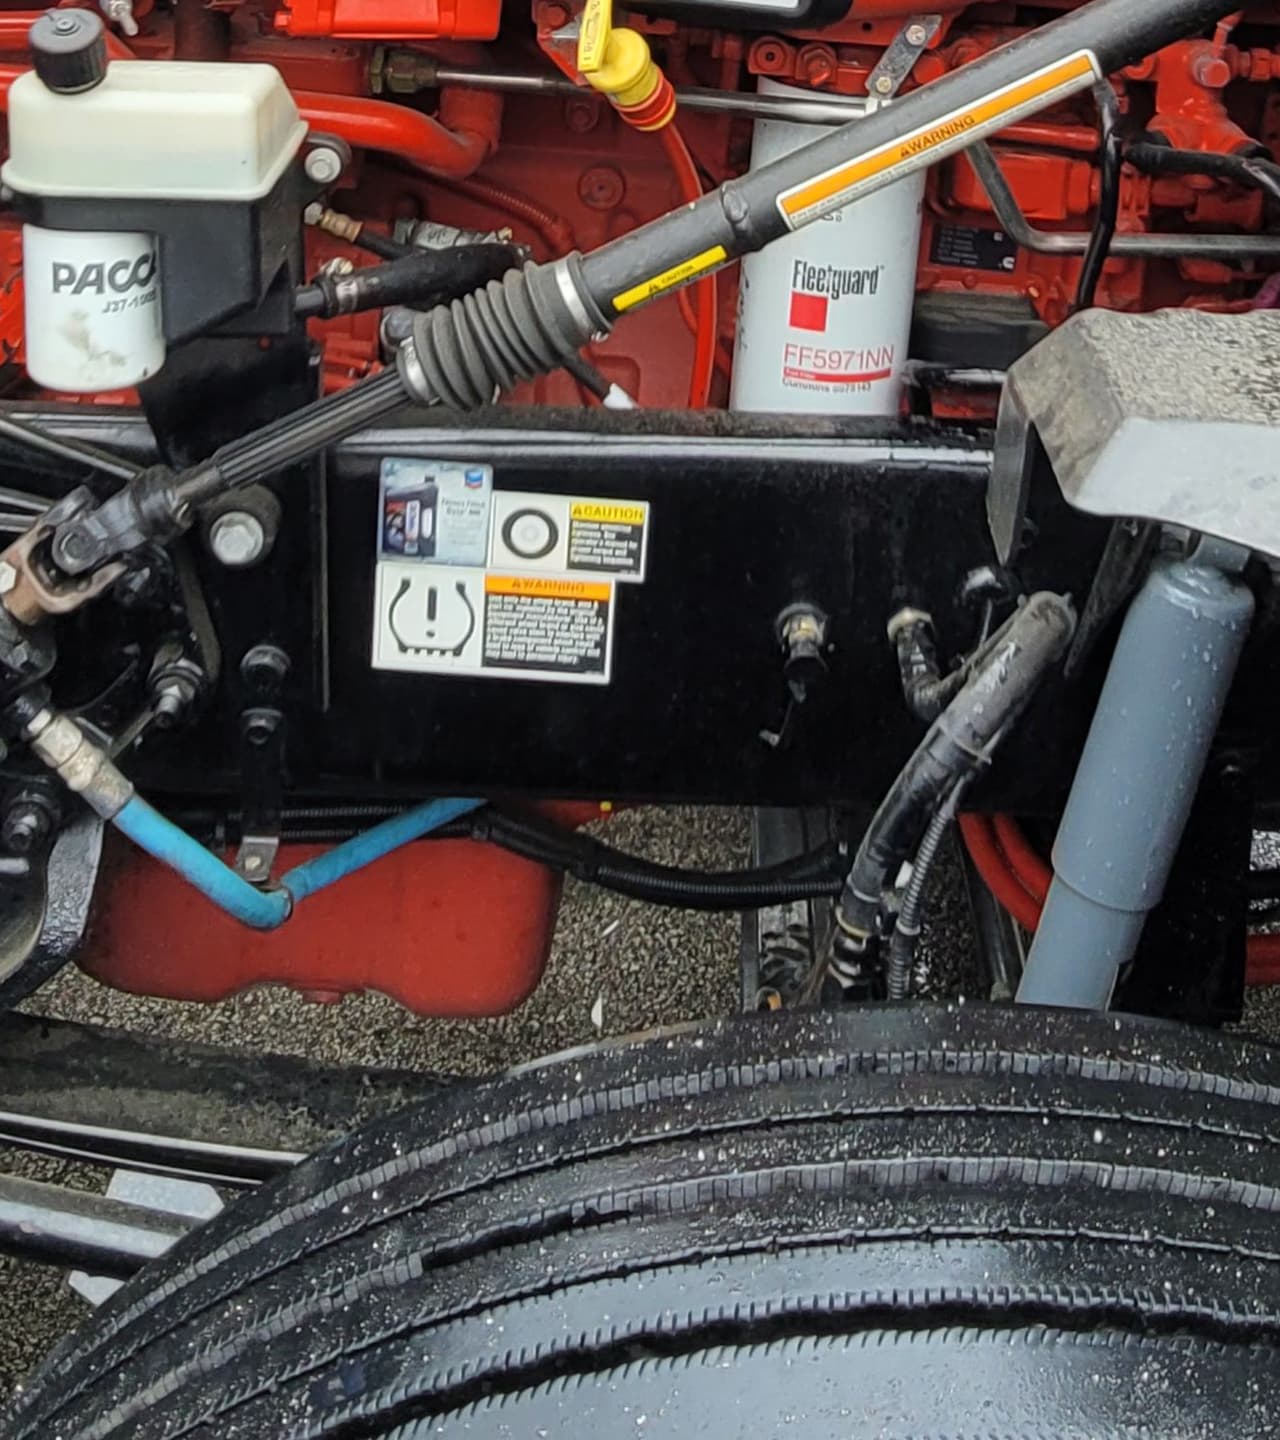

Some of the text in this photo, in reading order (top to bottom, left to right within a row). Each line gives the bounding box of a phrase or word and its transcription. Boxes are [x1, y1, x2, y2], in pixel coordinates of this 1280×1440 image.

[907, 115, 976, 154] WARNING
[792, 259, 880, 300] Fleetguard
[783, 342, 894, 371] FF5971NN
[584, 505, 643, 520] CAUTION
[523, 578, 585, 593] WARNING
